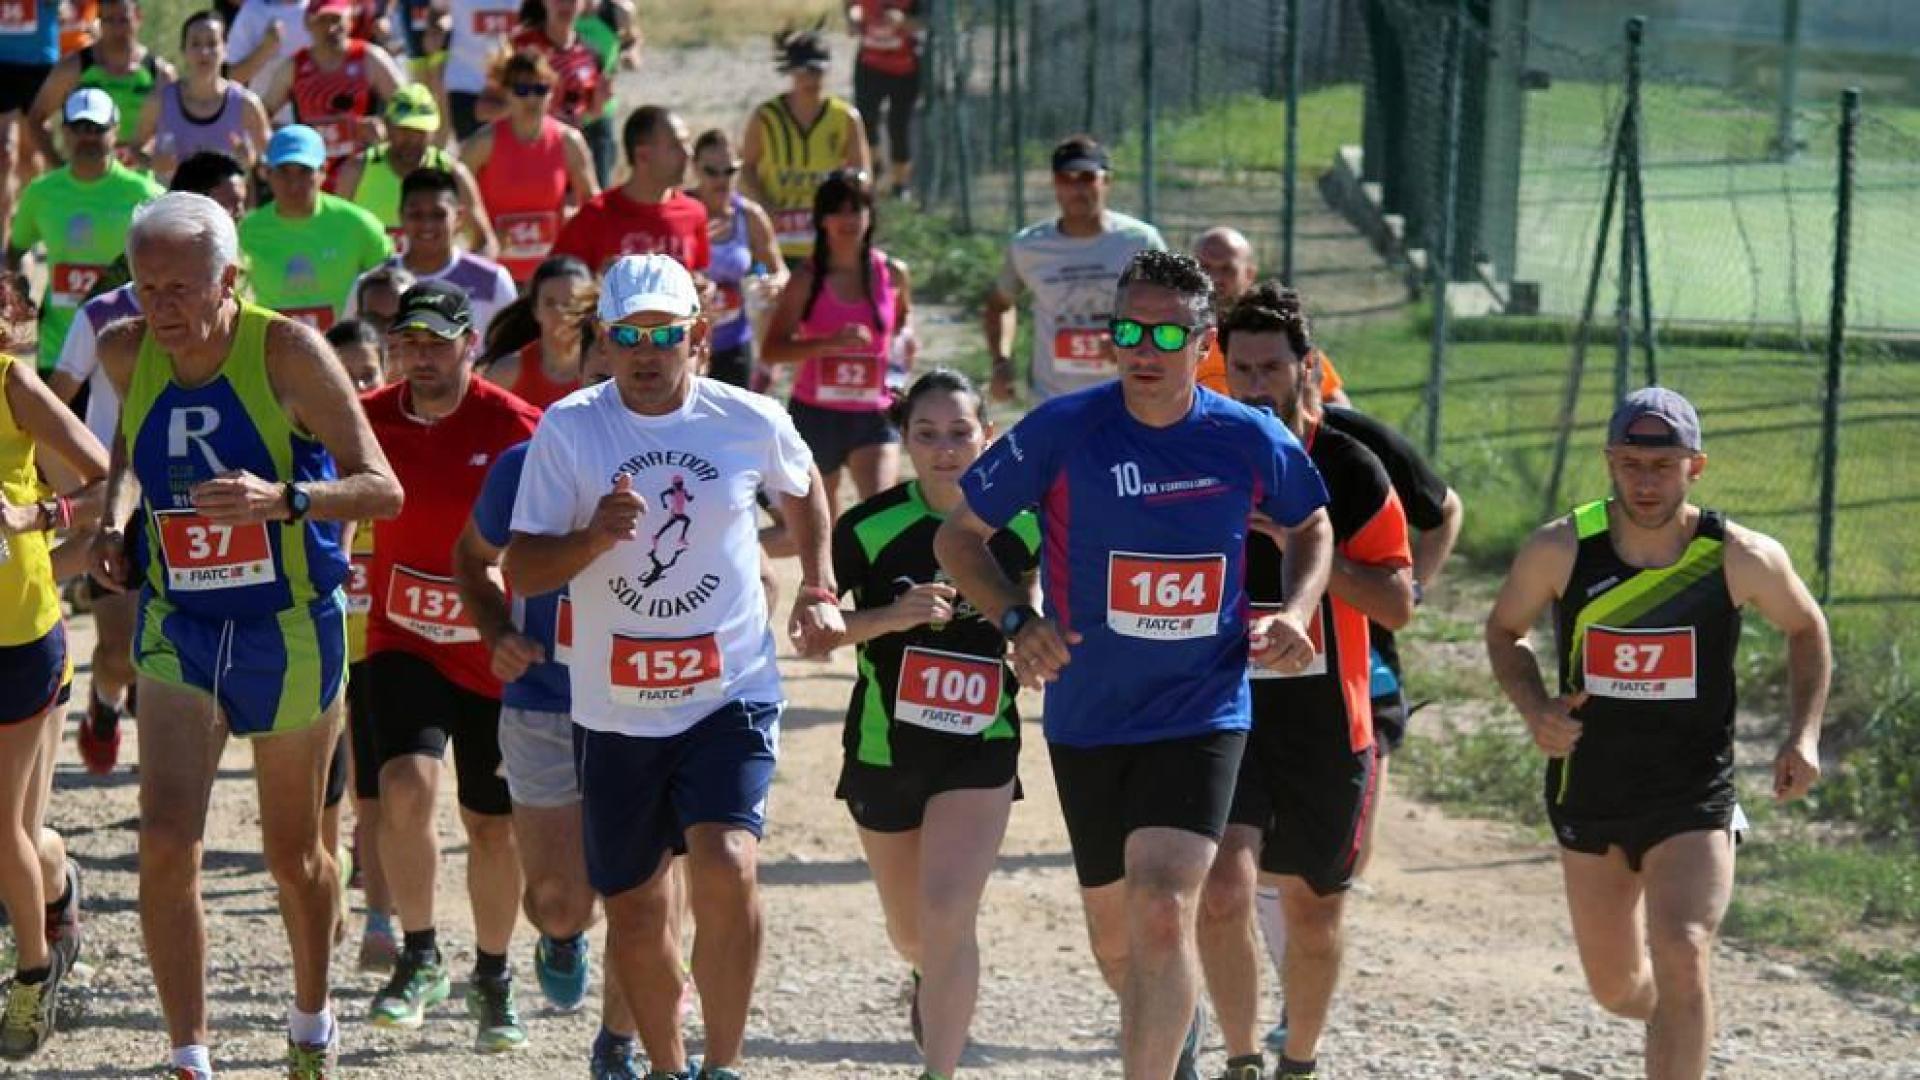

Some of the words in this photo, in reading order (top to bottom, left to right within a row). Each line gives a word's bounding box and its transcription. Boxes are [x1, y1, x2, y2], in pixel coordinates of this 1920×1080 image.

[1072, 335, 1100, 356] 53
[838, 363, 865, 385] 52
[168, 406, 229, 475] R
[1110, 461, 1141, 497] 10
[186, 525, 232, 560] 37
[190, 566, 228, 582] FIATC
[1129, 571, 1206, 608] 164
[406, 586, 464, 620] 137
[608, 573, 720, 619] SOLIDARIO
[1136, 617, 1181, 631] FIATC
[627, 648, 704, 682] 152
[1614, 643, 1665, 673] 87
[638, 688, 680, 701] FIATC
[920, 666, 986, 706] 100
[1611, 681, 1651, 693] FIATC
